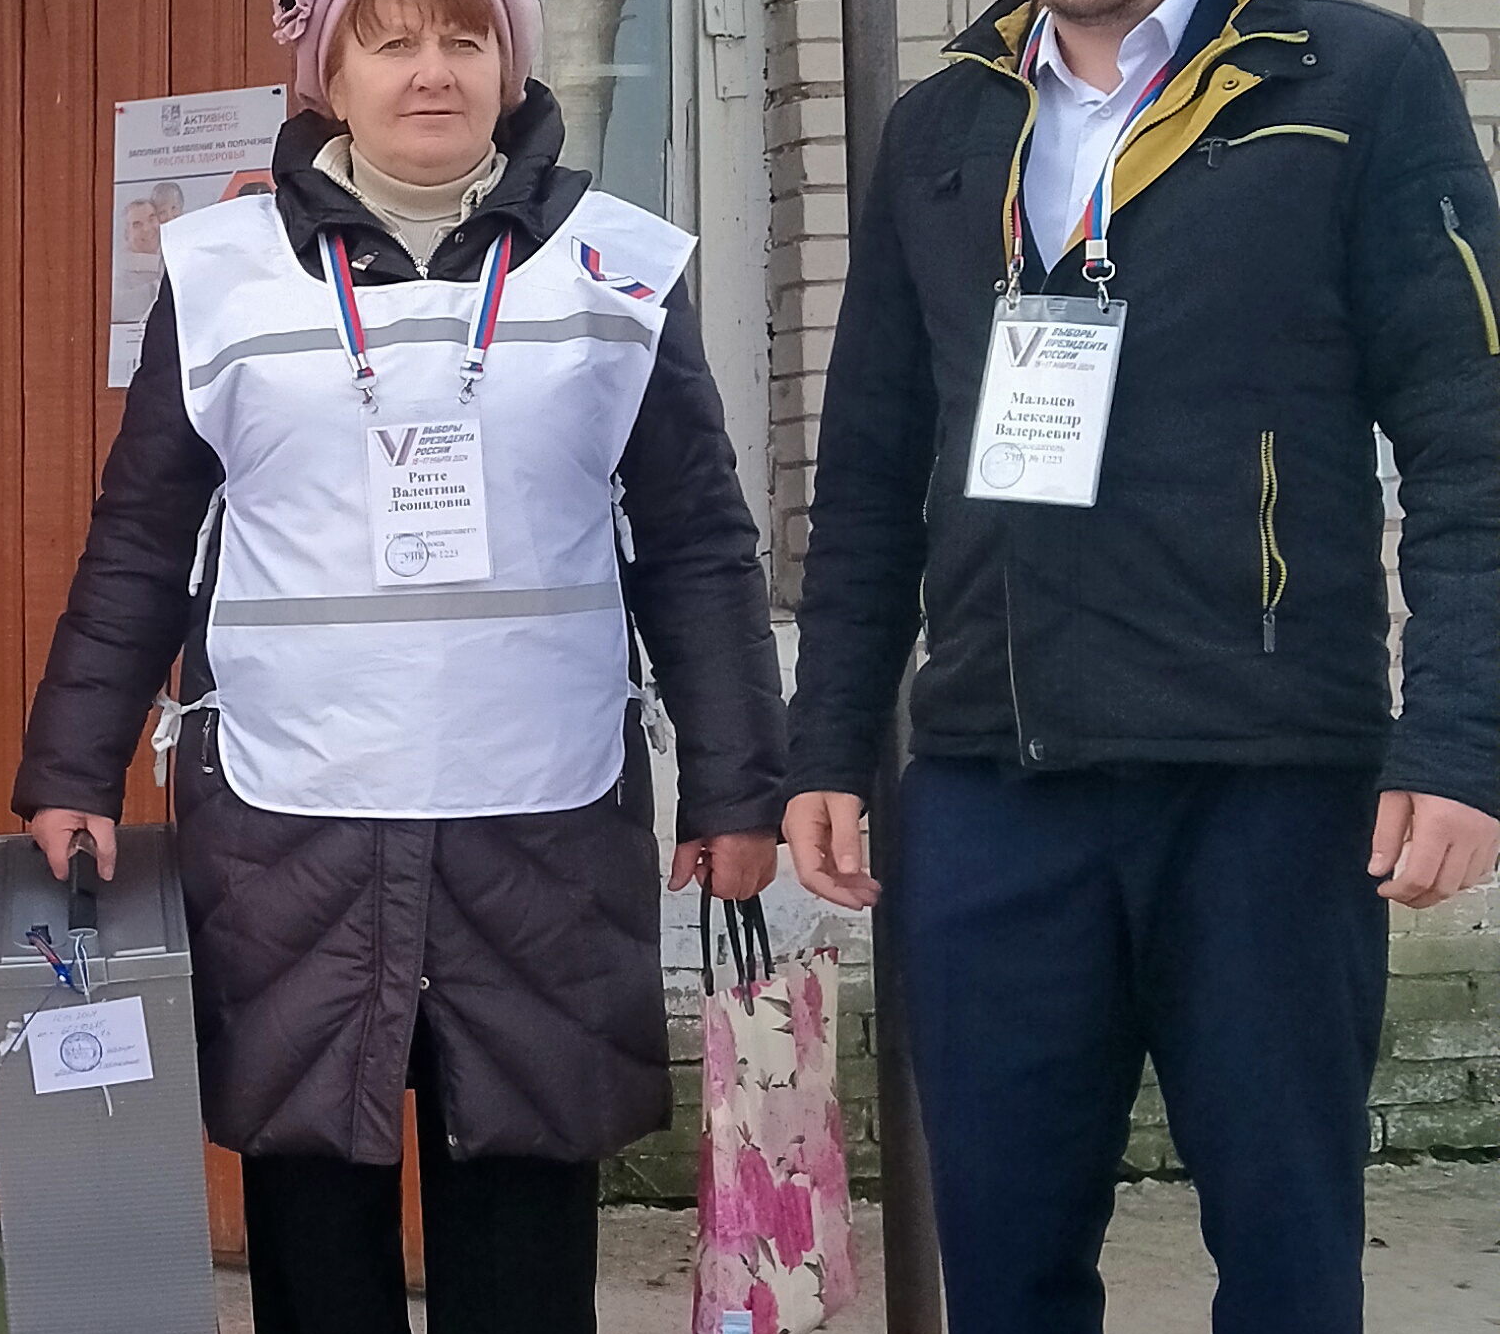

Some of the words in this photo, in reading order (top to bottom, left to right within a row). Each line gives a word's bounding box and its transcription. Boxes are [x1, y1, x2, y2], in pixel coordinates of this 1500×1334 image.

[1051, 327, 1097, 338] ВЫБОРЫ
[1044, 338, 1108, 351] ПРЕЗИДЕНТА
[1038, 349, 1079, 360] РОССИИ
[1010, 392, 1075, 408] Мальцев
[1002, 409, 1081, 428] Александр
[422, 424, 463, 435] ВЫБОРЫ
[995, 423, 1081, 440] Валерьевич
[418, 433, 475, 445] ПРЕЗИДЕНТА
[414, 446, 452, 456] РОССИИ
[391, 484, 466, 499] Валентина
[387, 498, 471, 513] Леонидовна
